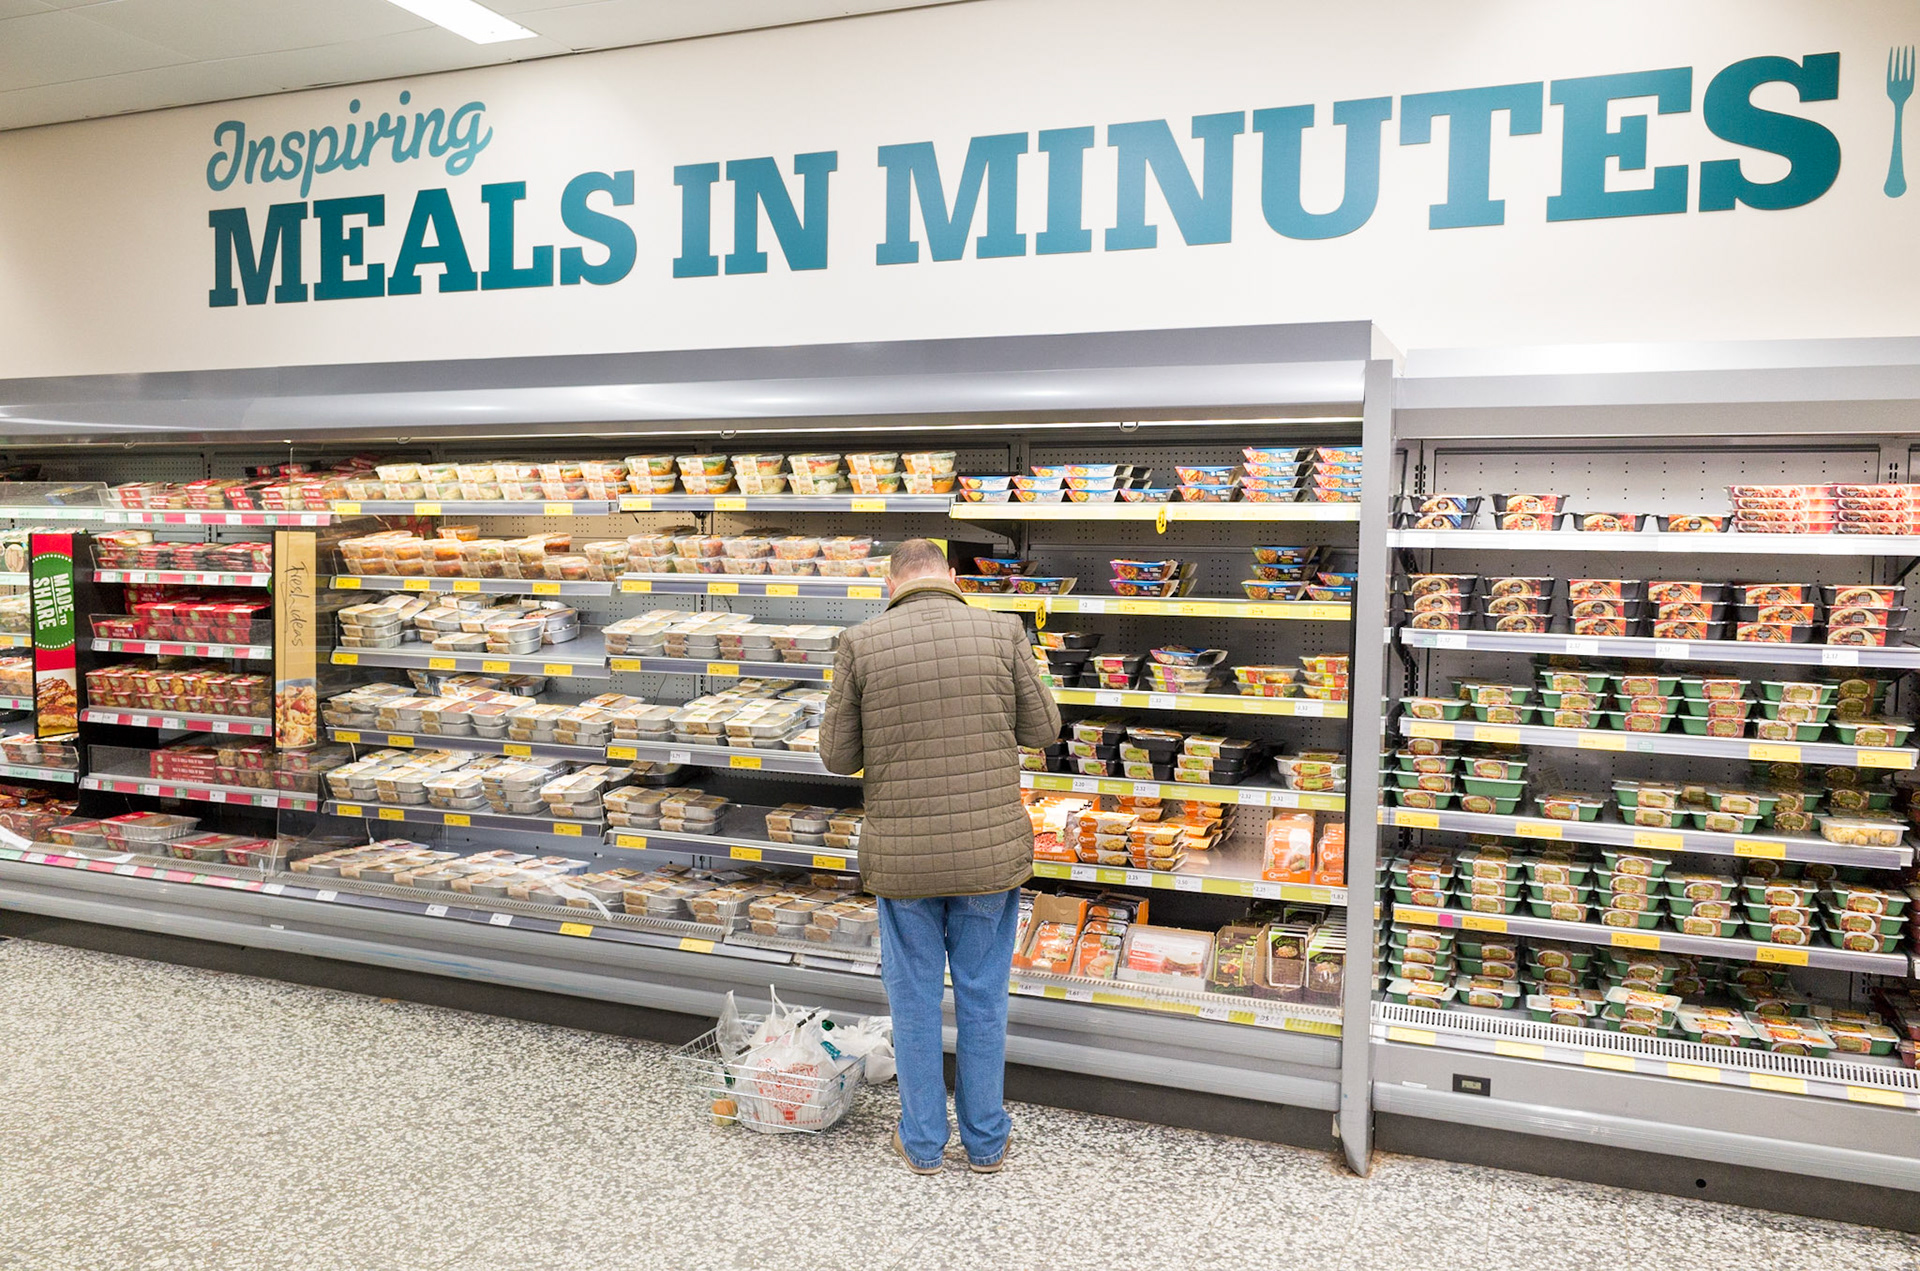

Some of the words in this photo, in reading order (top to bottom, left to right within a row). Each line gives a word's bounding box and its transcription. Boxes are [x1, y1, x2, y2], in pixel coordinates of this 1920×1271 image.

[206, 90, 493, 198] Inspiring
[209, 172, 637, 307] MEALS
[673, 151, 837, 278] IN
[876, 51, 1842, 265] MINUTES
[33, 576, 57, 631] SHARE
[53, 572, 74, 614] MADE
[284, 561, 310, 611] Fresh
[59, 613, 68, 625] TO
[288, 610, 308, 647] ideas
